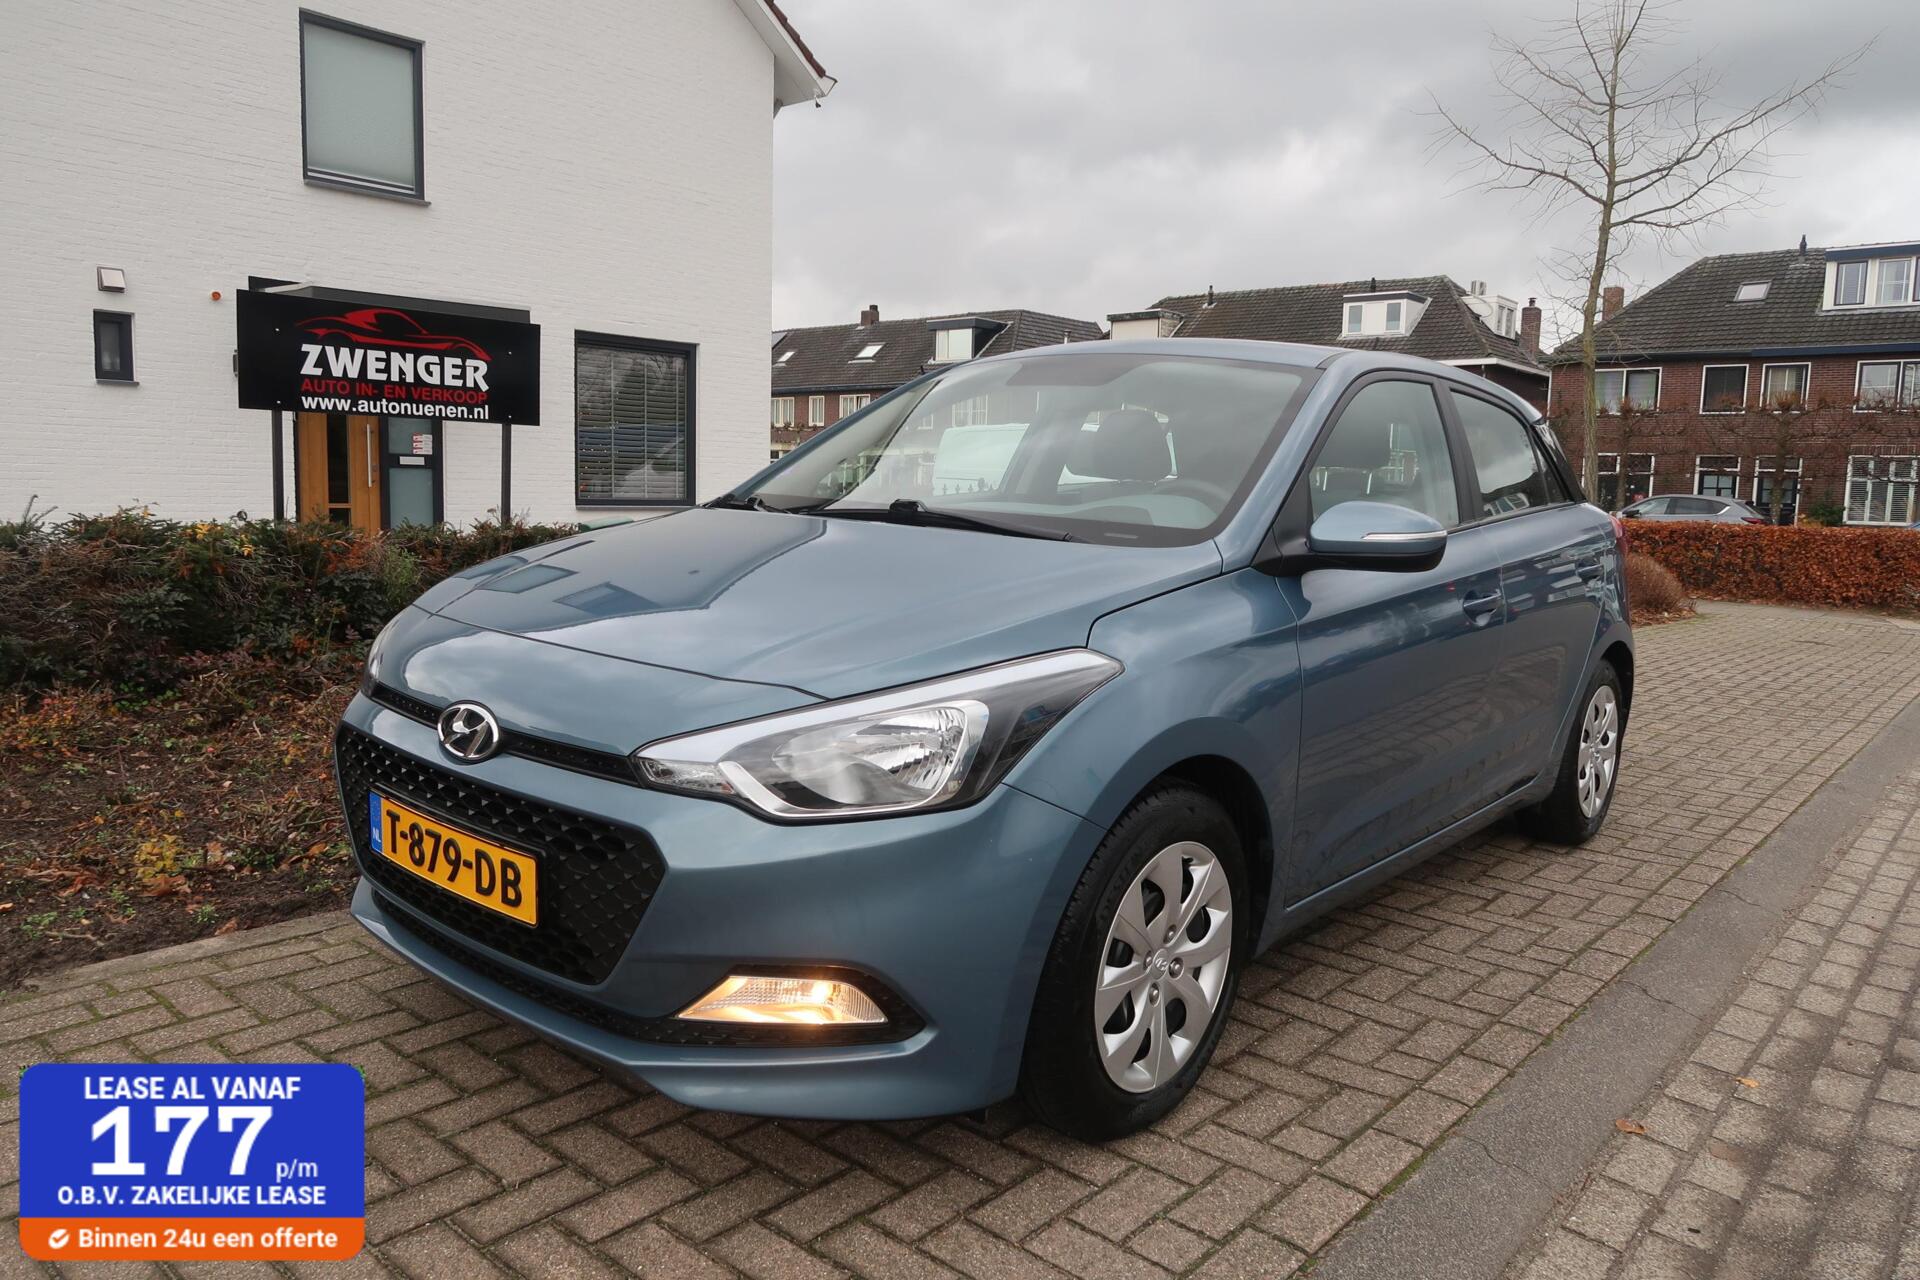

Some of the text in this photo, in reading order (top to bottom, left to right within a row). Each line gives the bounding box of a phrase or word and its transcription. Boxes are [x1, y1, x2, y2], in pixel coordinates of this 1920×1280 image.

[301, 344, 489, 391] ZWENGER
[302, 378, 487, 404] AUTO IN- EN VERKOOP
[301, 396, 489, 419] www.autonuenen.nl
[372, 827, 382, 843] NL
[386, 809, 522, 907] T-879-DB
